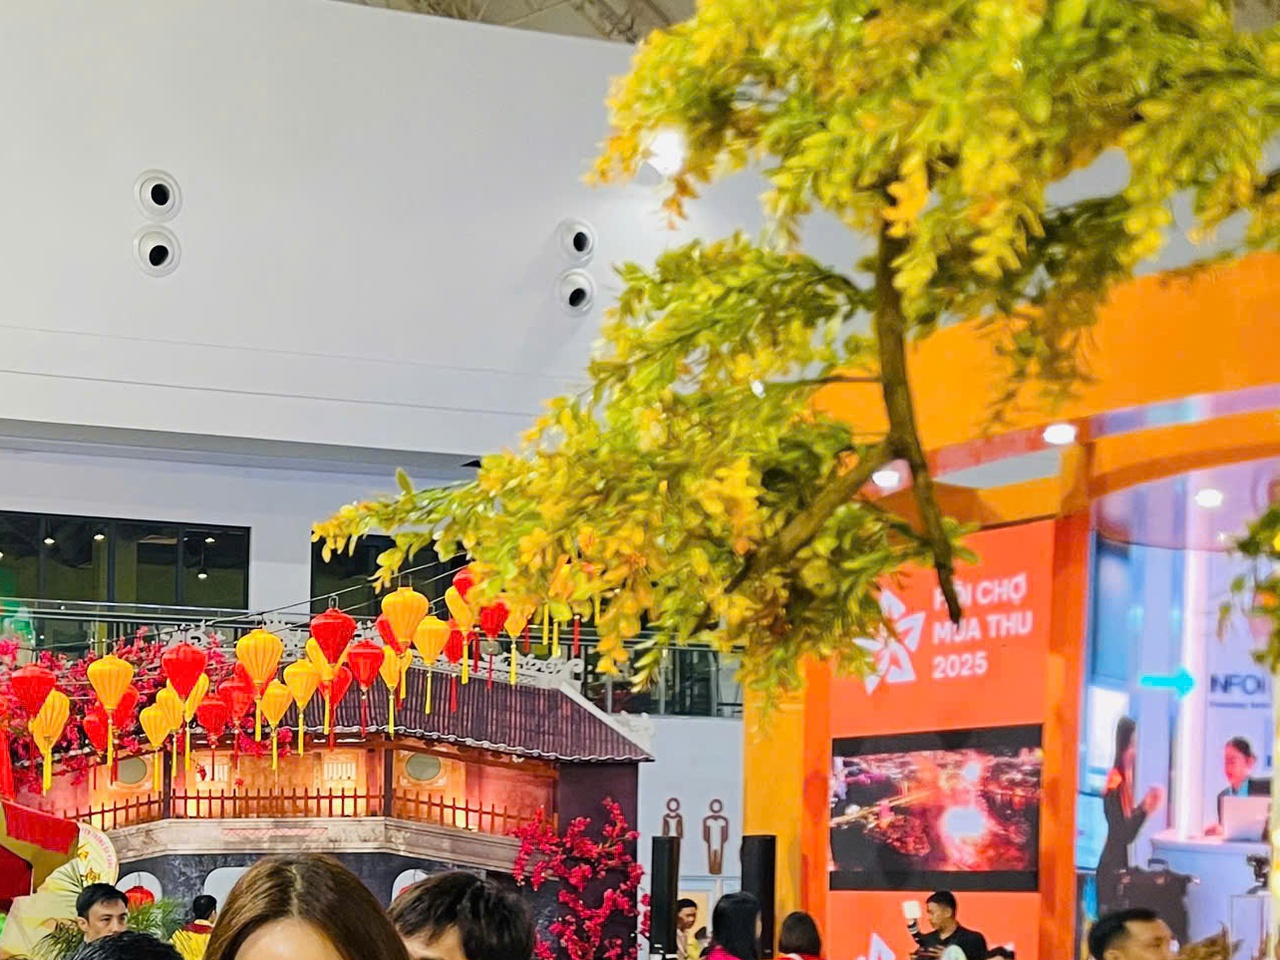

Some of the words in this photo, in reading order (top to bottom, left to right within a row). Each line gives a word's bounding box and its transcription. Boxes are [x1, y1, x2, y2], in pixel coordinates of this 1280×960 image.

[933, 579, 972, 611] HI
[976, 572, 1027, 605] CHỢ
[986, 610, 1033, 639] THU
[933, 651, 988, 679] 2025
